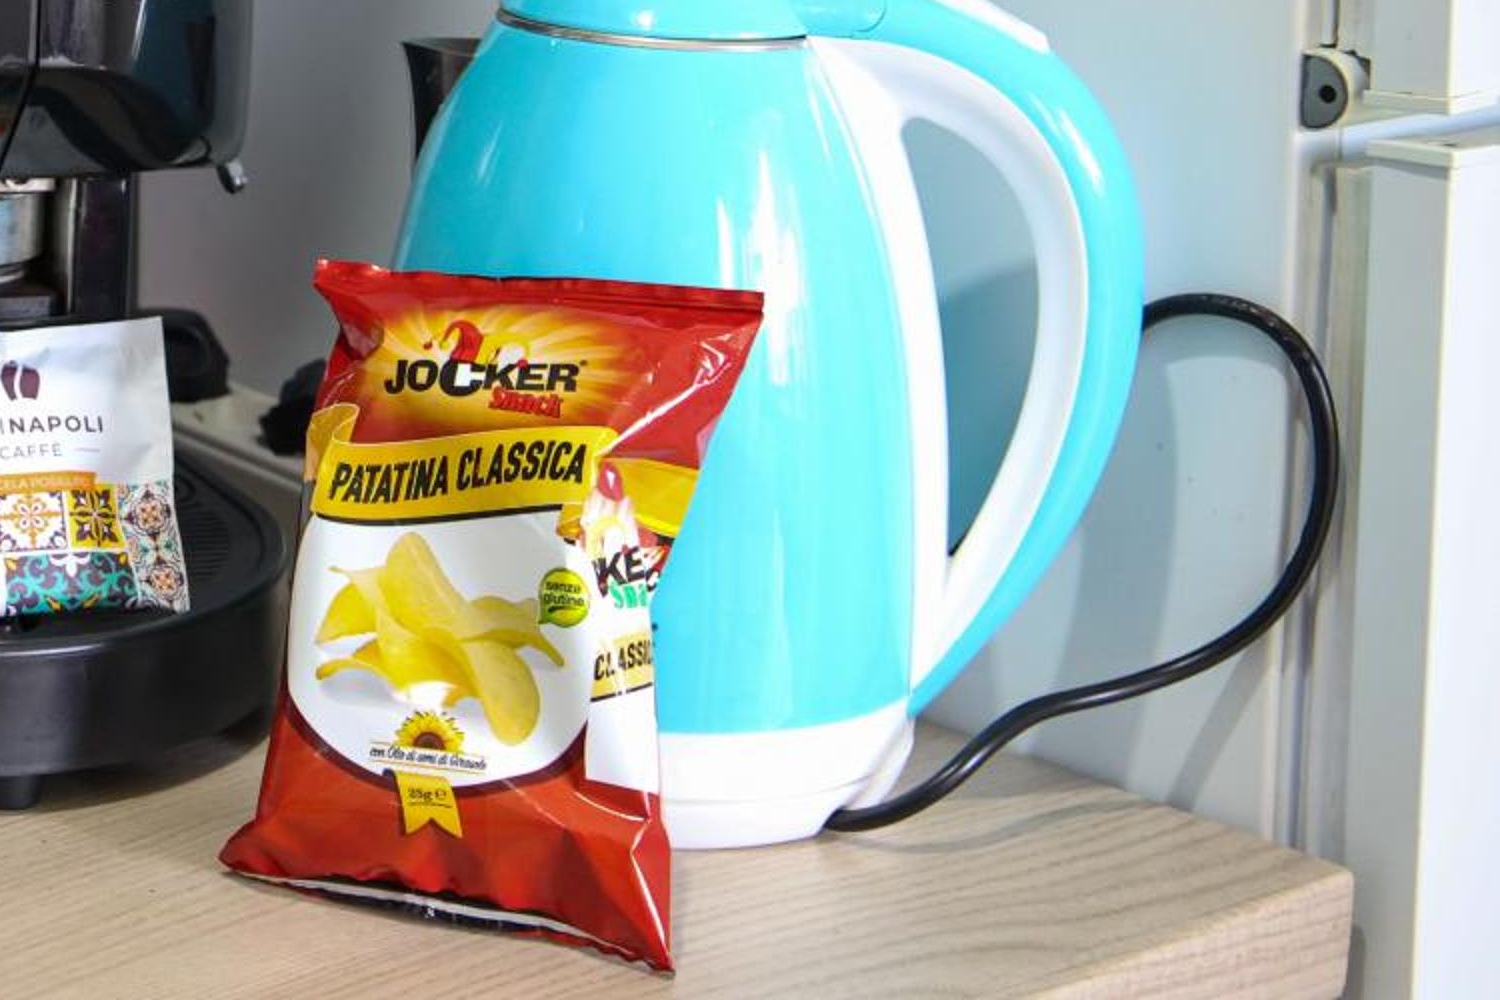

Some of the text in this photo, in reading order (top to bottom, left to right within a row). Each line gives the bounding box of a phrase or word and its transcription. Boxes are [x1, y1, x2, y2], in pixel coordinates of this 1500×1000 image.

[384, 357, 580, 397] JOCKER
[329, 440, 587, 505] PATATINA CLASSICA
